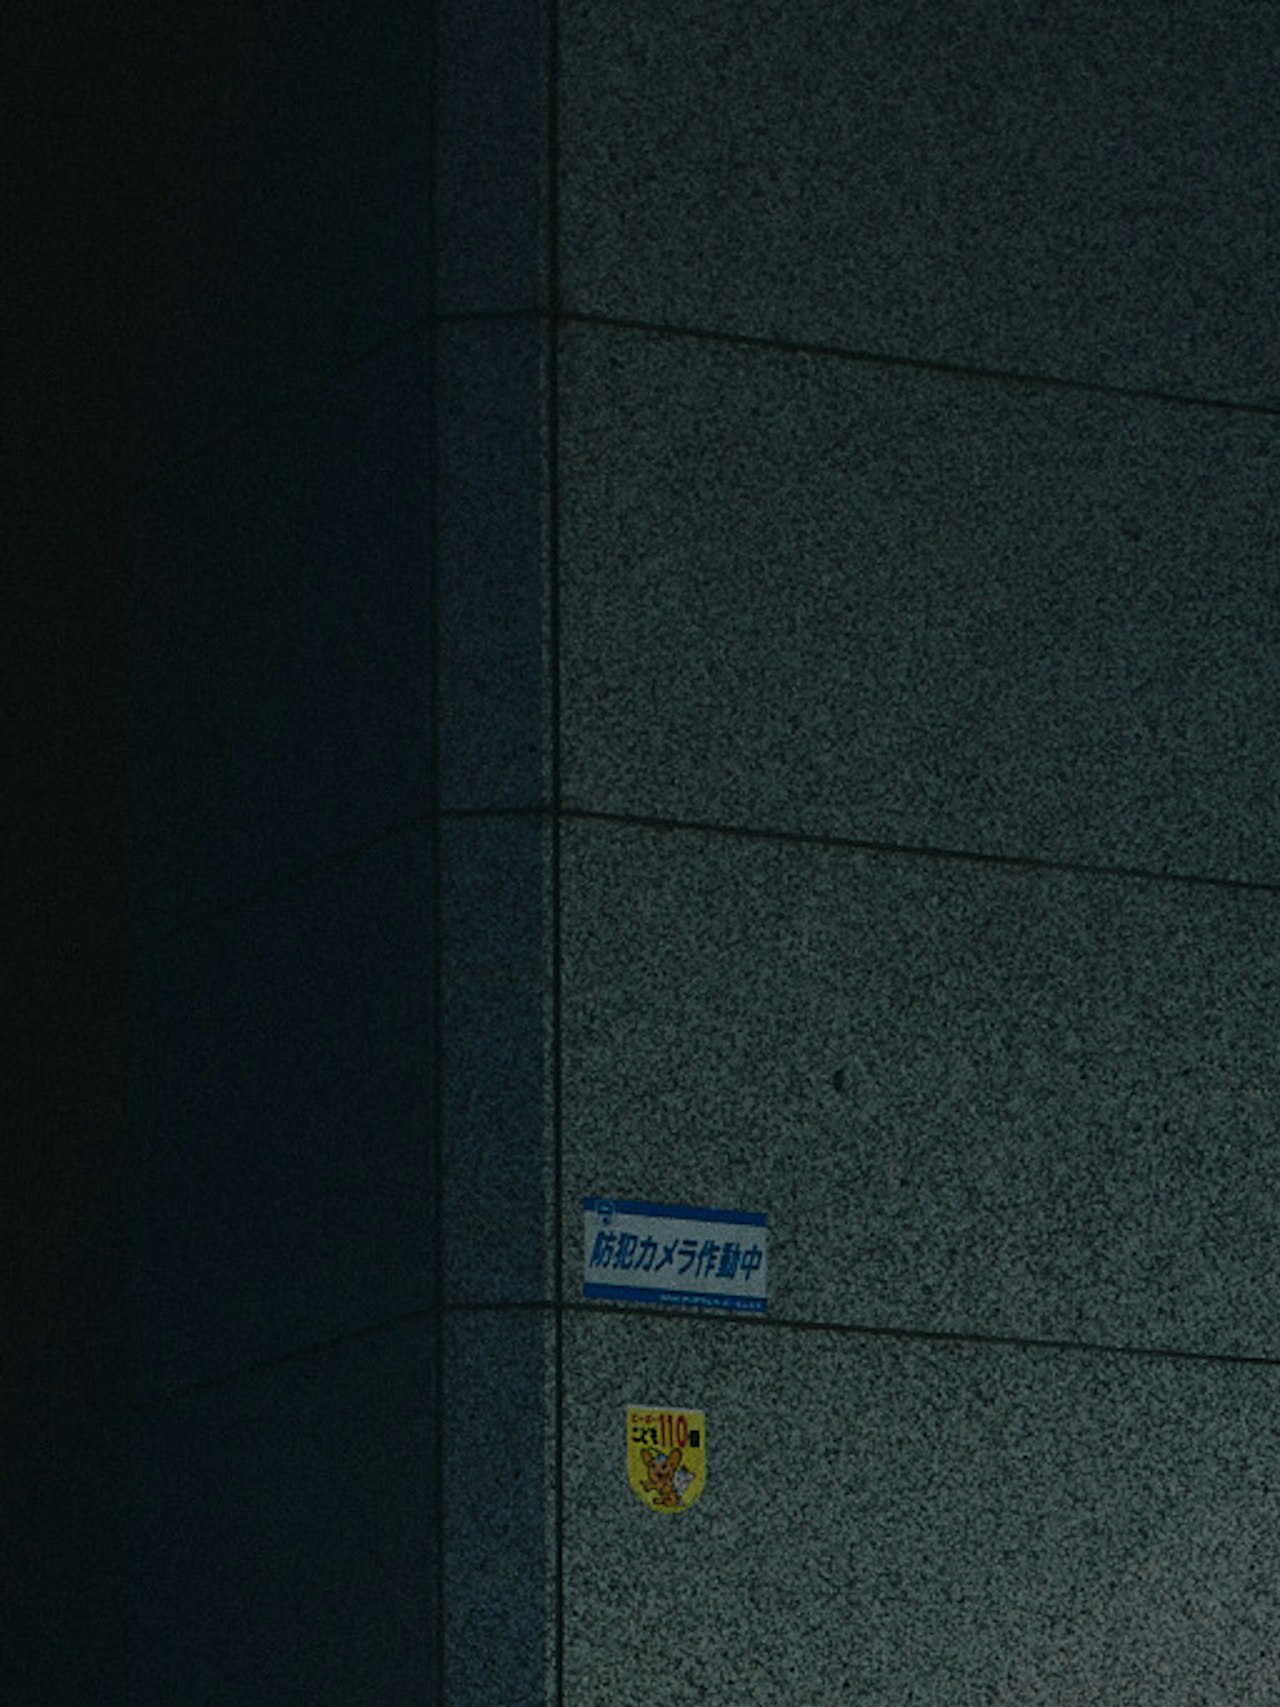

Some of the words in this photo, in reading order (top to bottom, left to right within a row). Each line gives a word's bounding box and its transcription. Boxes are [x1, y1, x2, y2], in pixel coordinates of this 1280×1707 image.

[590, 1231, 762, 1281] 防犯カメラ作動中
